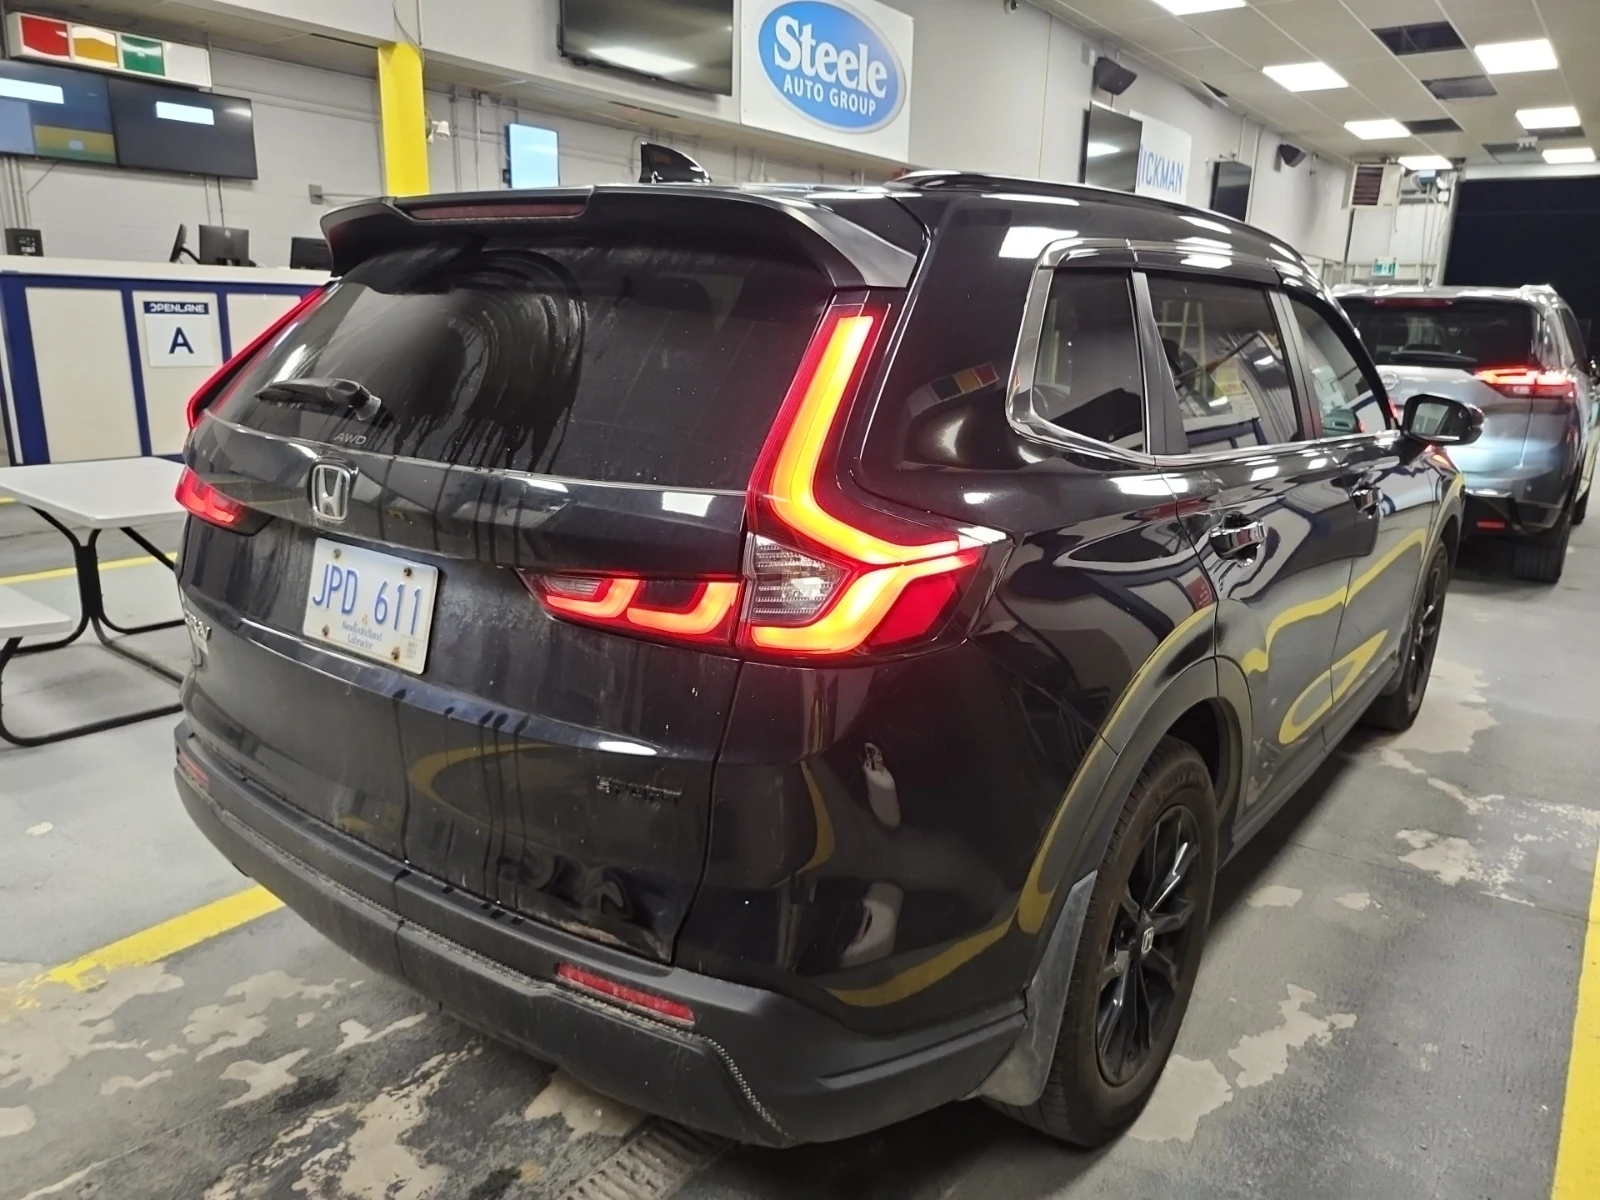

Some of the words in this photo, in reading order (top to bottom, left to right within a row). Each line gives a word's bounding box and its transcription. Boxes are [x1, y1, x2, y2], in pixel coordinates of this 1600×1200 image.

[774, 15, 887, 99] Steele
[783, 74, 824, 102] AUTO
[829, 88, 876, 117] GROUP
[149, 302, 205, 313] OPENLANE
[169, 326, 194, 354] A
[333, 432, 367, 445] AWD
[312, 563, 358, 615] JPD
[374, 580, 421, 636] 611
